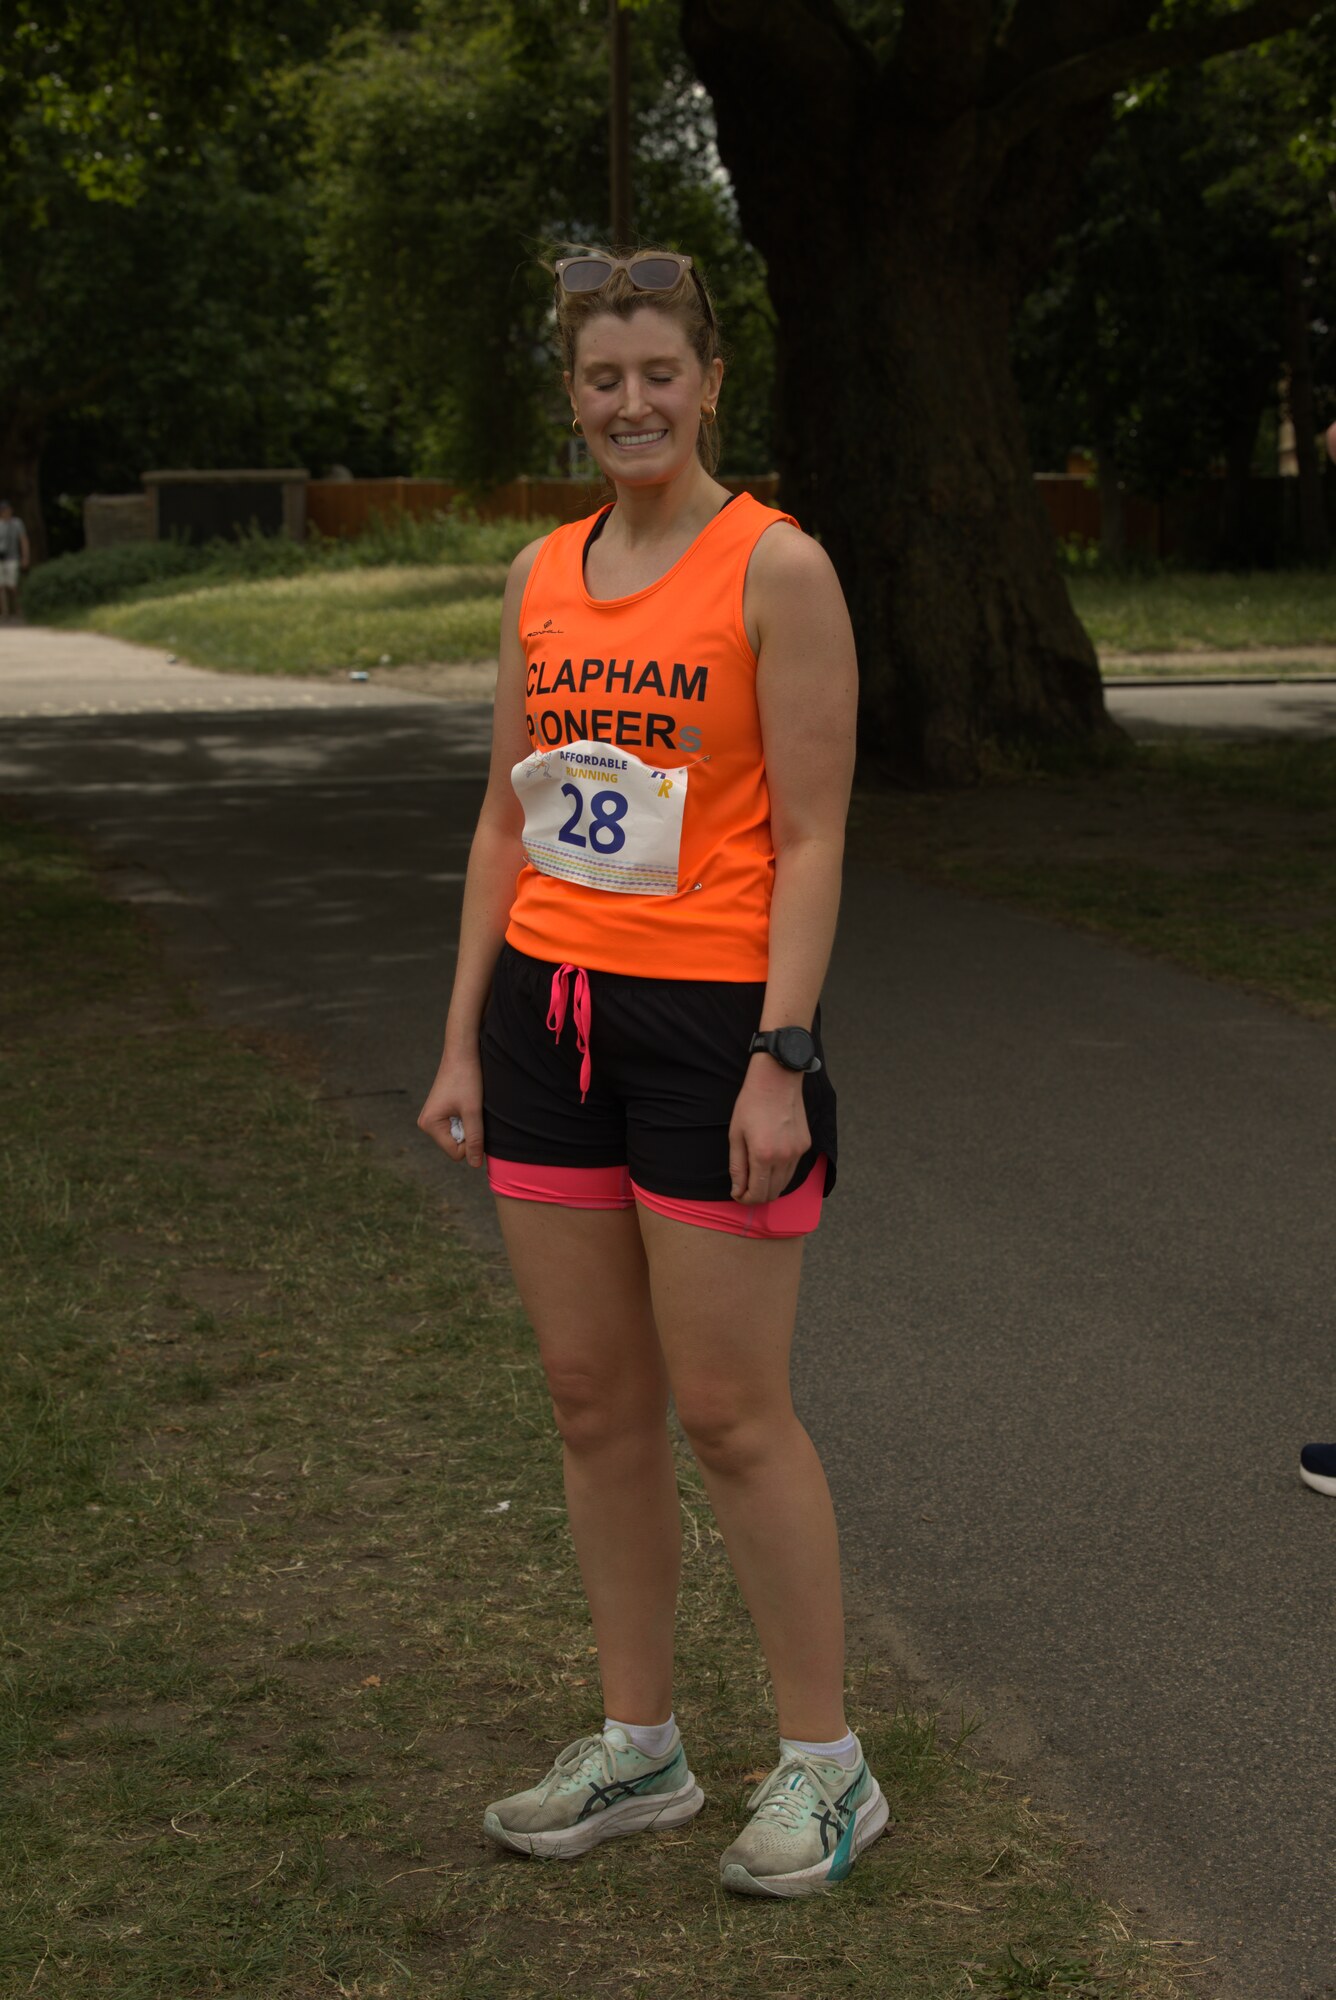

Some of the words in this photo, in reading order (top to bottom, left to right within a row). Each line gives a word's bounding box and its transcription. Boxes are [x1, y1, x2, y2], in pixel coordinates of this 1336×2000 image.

[526, 658, 709, 702] CLAPHAM
[560, 750, 628, 771] AFFORDABLE
[566, 766, 619, 784] RUNNING
[557, 782, 629, 855] 28
